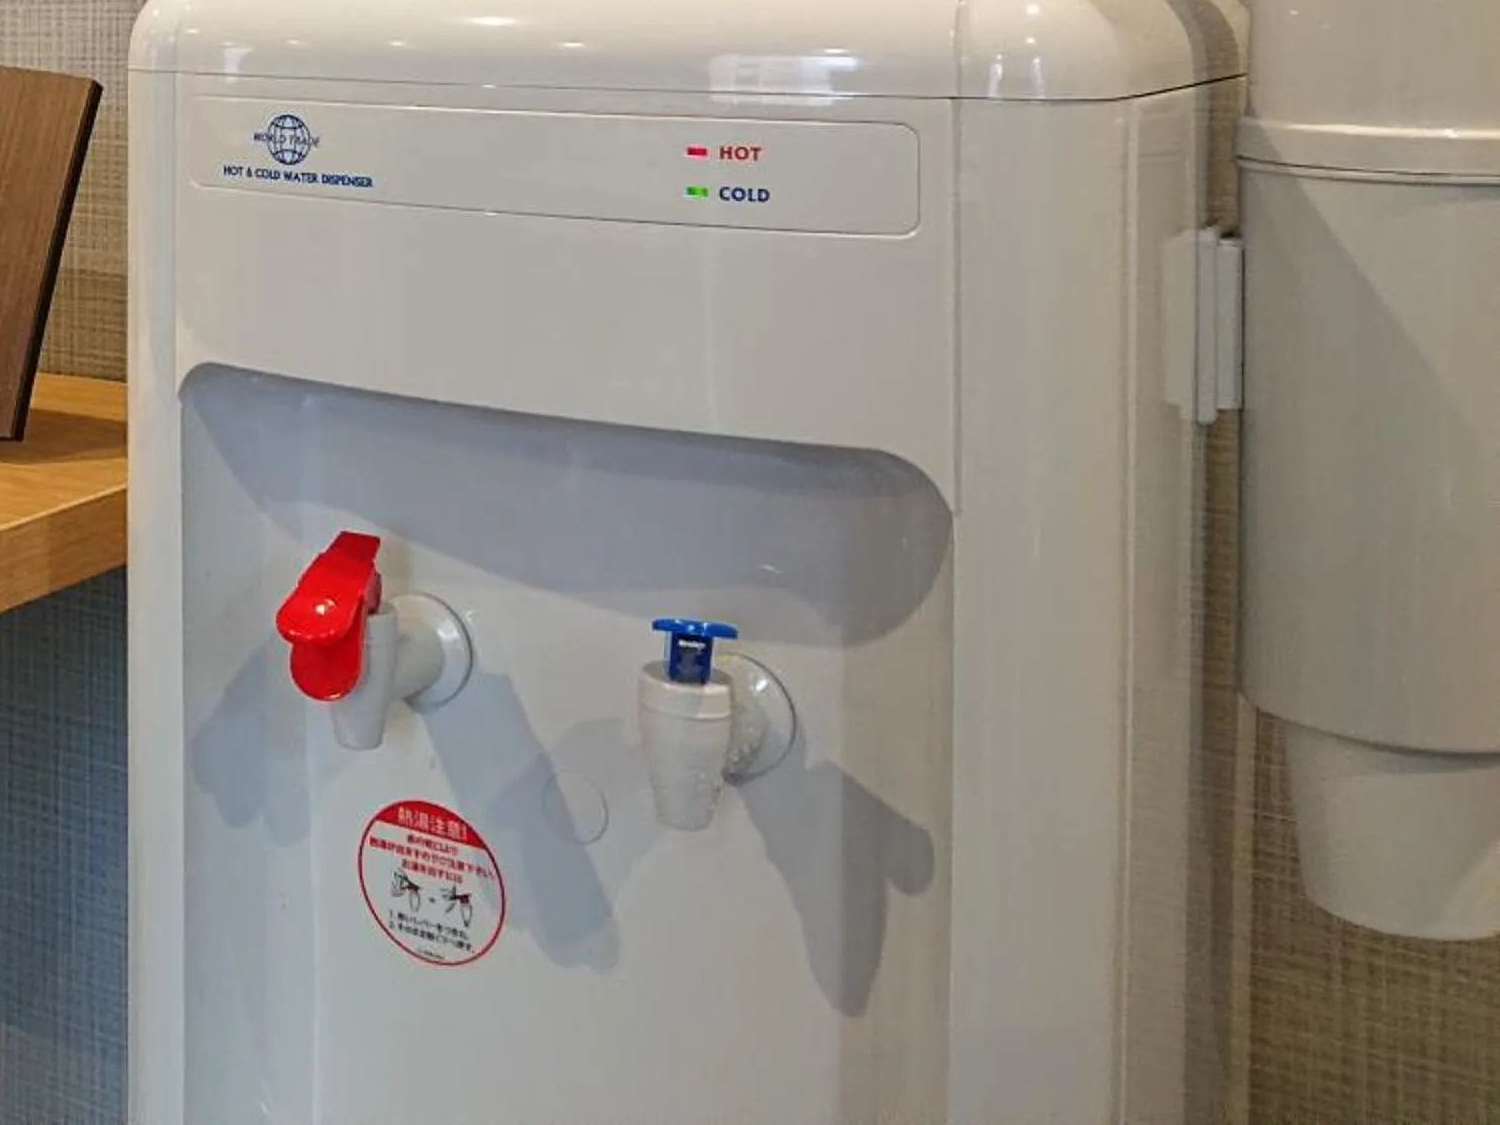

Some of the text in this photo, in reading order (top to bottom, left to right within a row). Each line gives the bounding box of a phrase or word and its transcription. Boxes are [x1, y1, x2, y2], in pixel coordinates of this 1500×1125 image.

[719, 146, 762, 161] HOT
[223, 165, 243, 175] HOT
[255, 168, 280, 180] COLD
[284, 170, 318, 184] WATER
[322, 173, 373, 188] DISPENSER
[719, 186, 771, 203] COLD
